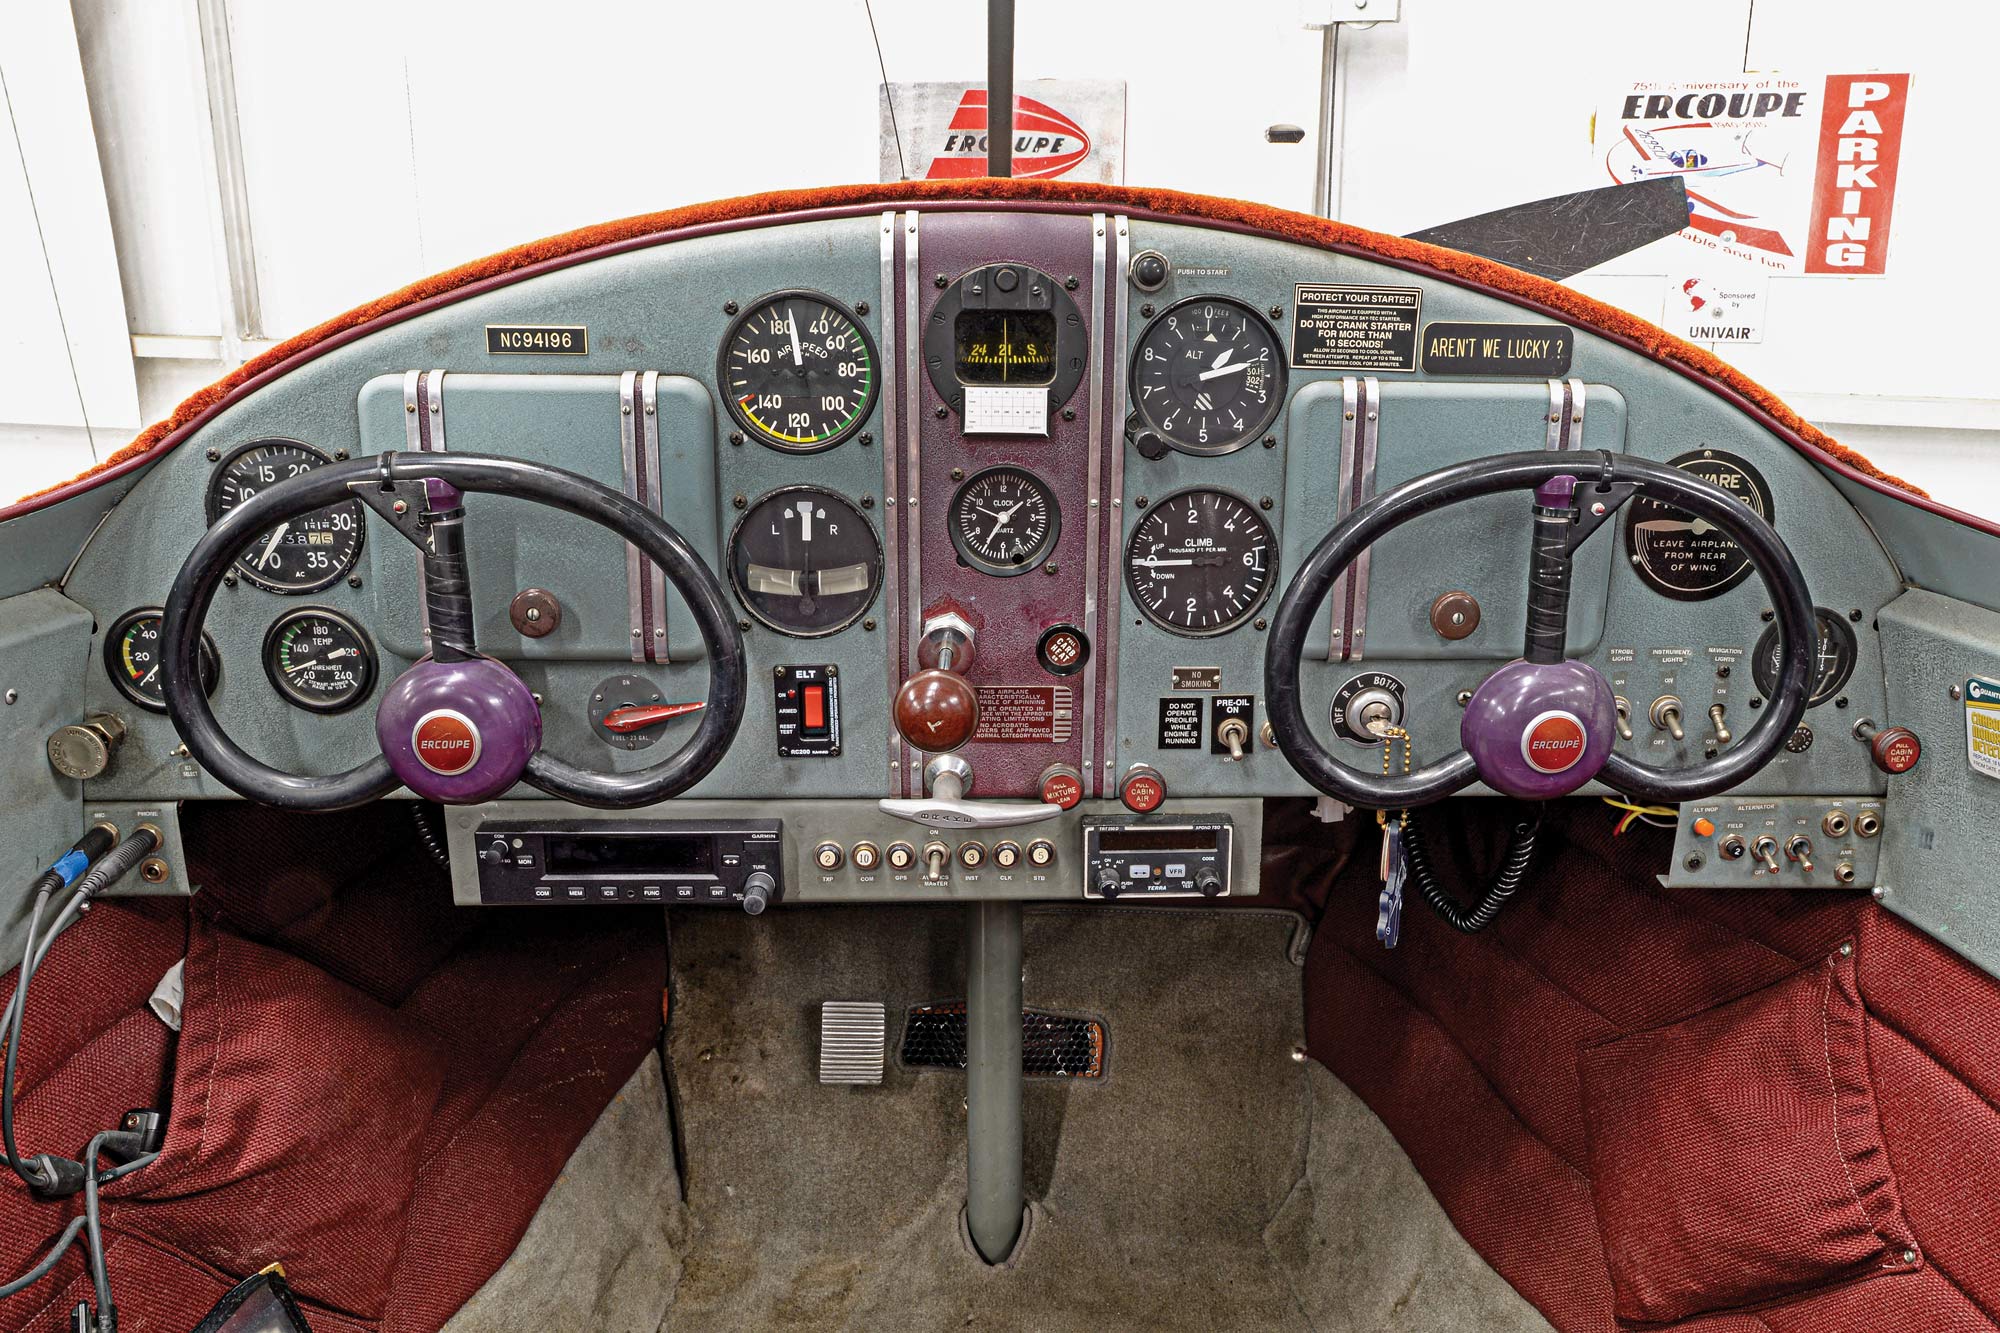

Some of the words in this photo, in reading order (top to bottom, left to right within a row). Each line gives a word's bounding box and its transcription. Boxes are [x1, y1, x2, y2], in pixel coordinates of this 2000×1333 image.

[1668, 82, 1749, 90] niversary
[1756, 80, 1769, 89] of
[1777, 80, 1799, 88] the
[1621, 92, 1807, 119] ERCOUPE
[944, 135, 1065, 153] ERCUPE
[1825, 81, 1890, 267] PARKING
[1723, 247, 1752, 260] and
[1761, 257, 1785, 270] fun
[1302, 293, 1343, 301] PROTECT
[1345, 294, 1370, 302] YOUR
[1371, 295, 1414, 303] STARTER!
[1719, 292, 1755, 300] Sponsored
[1204, 305, 1213, 319] 0
[770, 320, 791, 335] 180
[809, 320, 828, 335] 40
[1168, 316, 1177, 331] 9
[1300, 320, 1313, 328] DO
[1337, 321, 1368, 329] CRANK
[1371, 322, 1411, 331] STARTER
[1318, 329, 1337, 337] FOR
[1339, 330, 1365, 338] MORE
[1368, 331, 1392, 339] THAN
[1689, 326, 1751, 339] UNIVAIR
[500, 332, 572, 348] NC94196
[826, 335, 845, 350] 60
[1326, 339, 1335, 347] 10
[1338, 340, 1383, 348] SECONDS!
[777, 346, 792, 359] AIR
[798, 342, 828, 359] PEED
[971, 344, 987, 356] 24
[999, 344, 1012, 356] 21
[1027, 344, 1037, 356] S
[1144, 347, 1153, 361] 8
[1186, 350, 1203, 359] ALT
[1259, 347, 1268, 361] 2
[1430, 338, 1476, 358] AREN'T
[1483, 338, 1501, 358] WE
[1508, 339, 1550, 358] LUCKY
[1556, 340, 1564, 359] ?
[747, 348, 770, 363] 160
[838, 362, 856, 377] 80
[1143, 386, 1152, 399] 7
[1258, 390, 1266, 403] 3
[758, 394, 782, 409] 140
[822, 396, 844, 411] 100
[788, 413, 810, 428] 120
[1163, 417, 1172, 430] 6
[1234, 418, 1244, 431] 4
[1199, 429, 1208, 443] 5
[259, 465, 276, 482] 15
[1000, 485, 1007, 493] 12
[331, 513, 350, 530] 30
[1188, 510, 1198, 523] 2
[772, 524, 780, 535] L
[830, 524, 838, 535] R
[1224, 519, 1235, 532] 4
[1185, 538, 1213, 547] CLIMB
[269, 552, 281, 569] 0
[307, 552, 328, 568] 35
[1243, 552, 1253, 566] 6
[1223, 585, 1234, 598] 4
[1187, 598, 1197, 612] 2
[142, 630, 157, 639] 40
[313, 626, 328, 635] 180
[293, 644, 309, 653] 140
[1050, 644, 1070, 662] HEAT
[1057, 638, 1076, 657] CARB
[135, 652, 150, 661] 20
[303, 671, 315, 679] 40
[334, 671, 352, 680] 240
[796, 670, 816, 678] ELT
[1192, 671, 1202, 679] NO
[1181, 680, 1211, 688] SMOKING
[1357, 680, 1364, 688] L
[1374, 676, 1398, 691] BOTH
[1342, 690, 1351, 698] R
[1216, 699, 1250, 707] PRE-OIL
[1335, 707, 1344, 723] OFF
[421, 739, 470, 750] ERCOUPE
[1532, 740, 1580, 751] ERCOUPE
[1047, 786, 1076, 800] MIXTURE
[920, 813, 972, 823] BRAKE
[860, 854, 869, 863] 10
